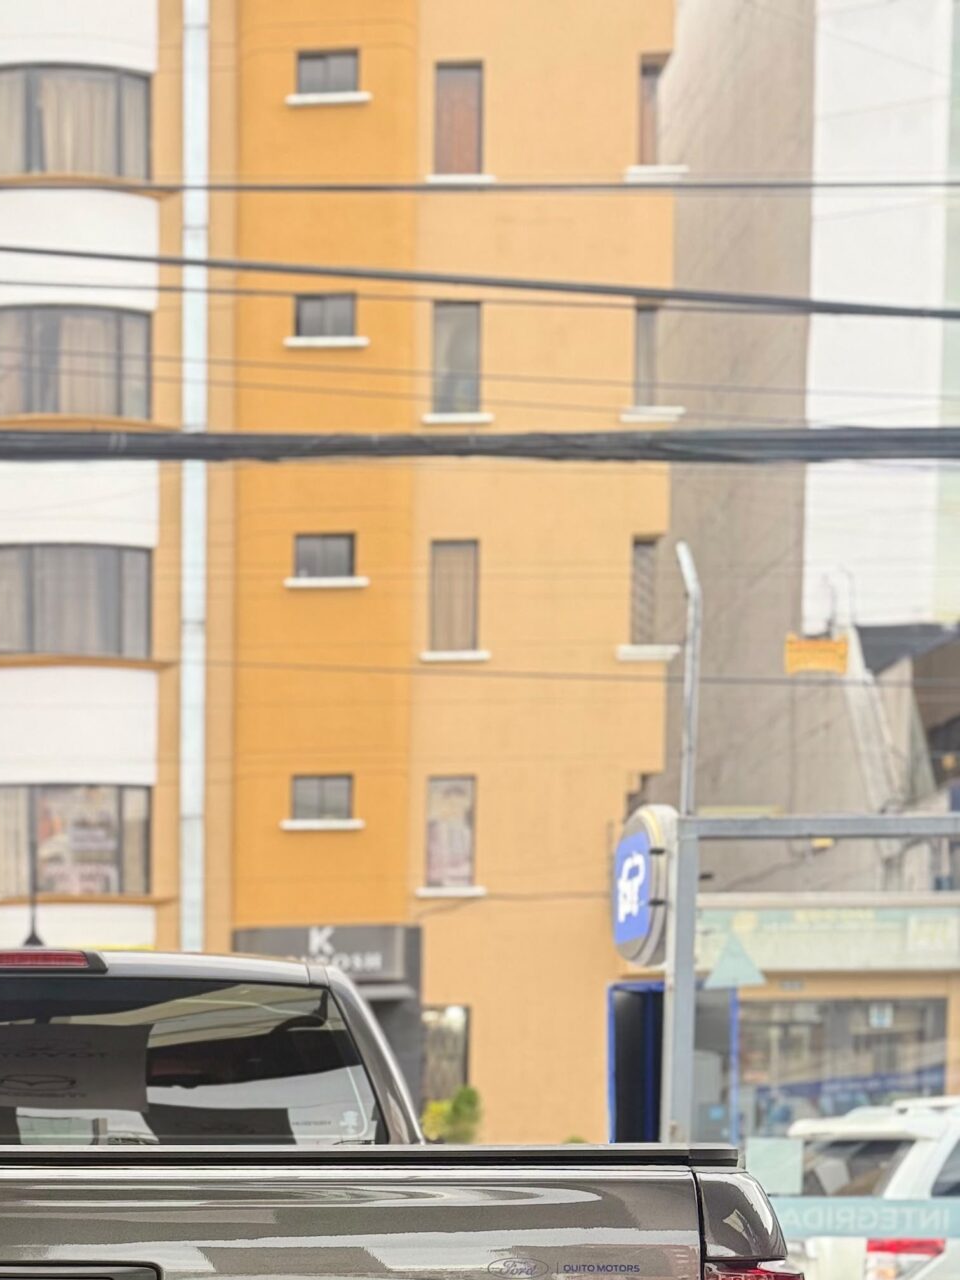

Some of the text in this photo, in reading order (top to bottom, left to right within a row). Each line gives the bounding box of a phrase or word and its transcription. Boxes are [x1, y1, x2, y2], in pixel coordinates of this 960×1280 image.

[499, 1260, 640, 1276] Ford QUITO MOTORS
